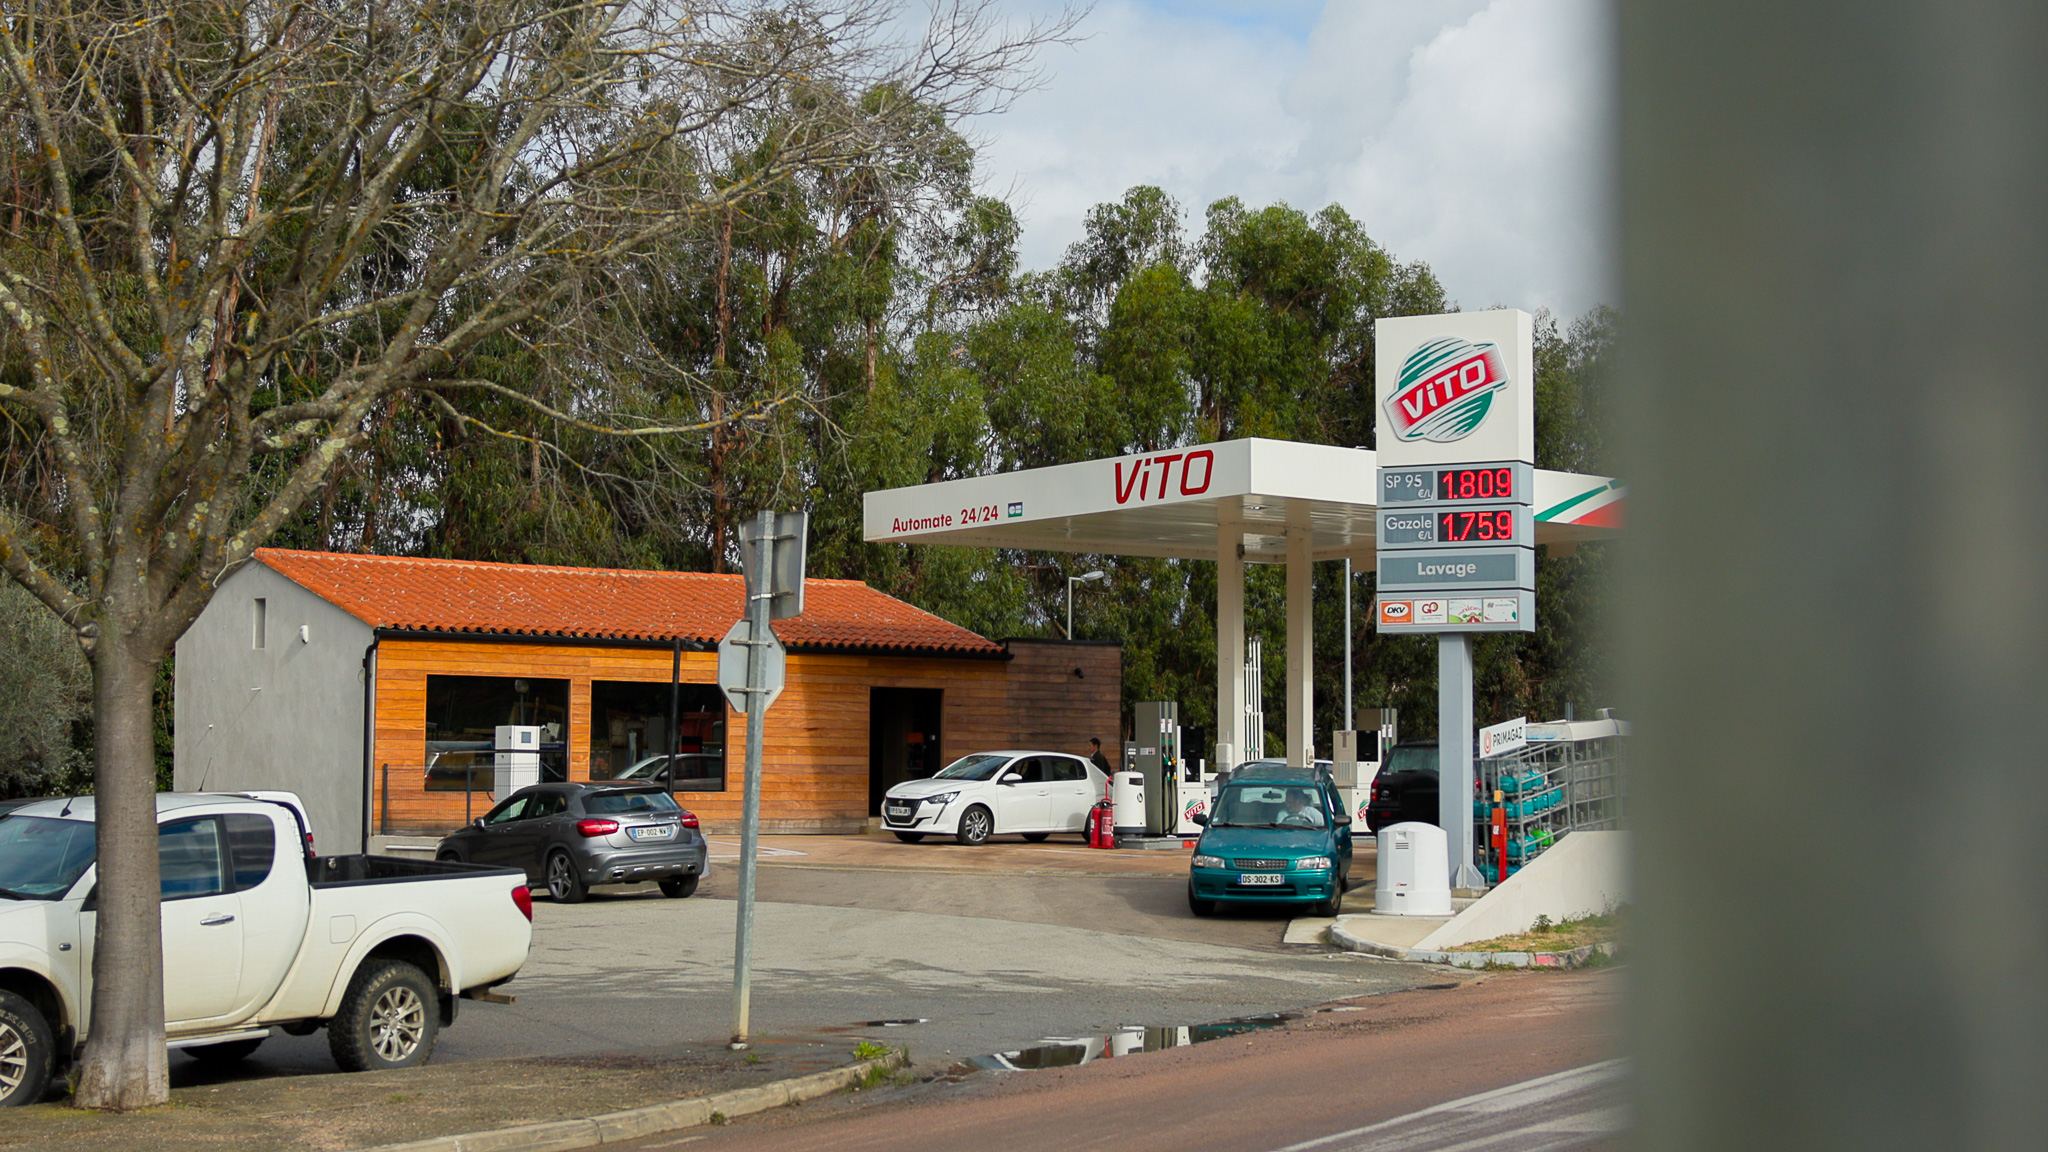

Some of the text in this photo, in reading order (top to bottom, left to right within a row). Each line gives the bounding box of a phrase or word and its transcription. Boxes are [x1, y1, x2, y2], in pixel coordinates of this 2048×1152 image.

[1385, 474, 1423, 489] SP 95
[1442, 468, 1512, 499] 1.809
[892, 505, 998, 533] Automate 24/24
[1385, 515, 1432, 530] Gazole
[1442, 511, 1513, 542] 1.759
[1417, 561, 1477, 577] Lavage
[1386, 606, 1406, 614] DKV
[1492, 726, 1523, 747] PRIMAGAZ
